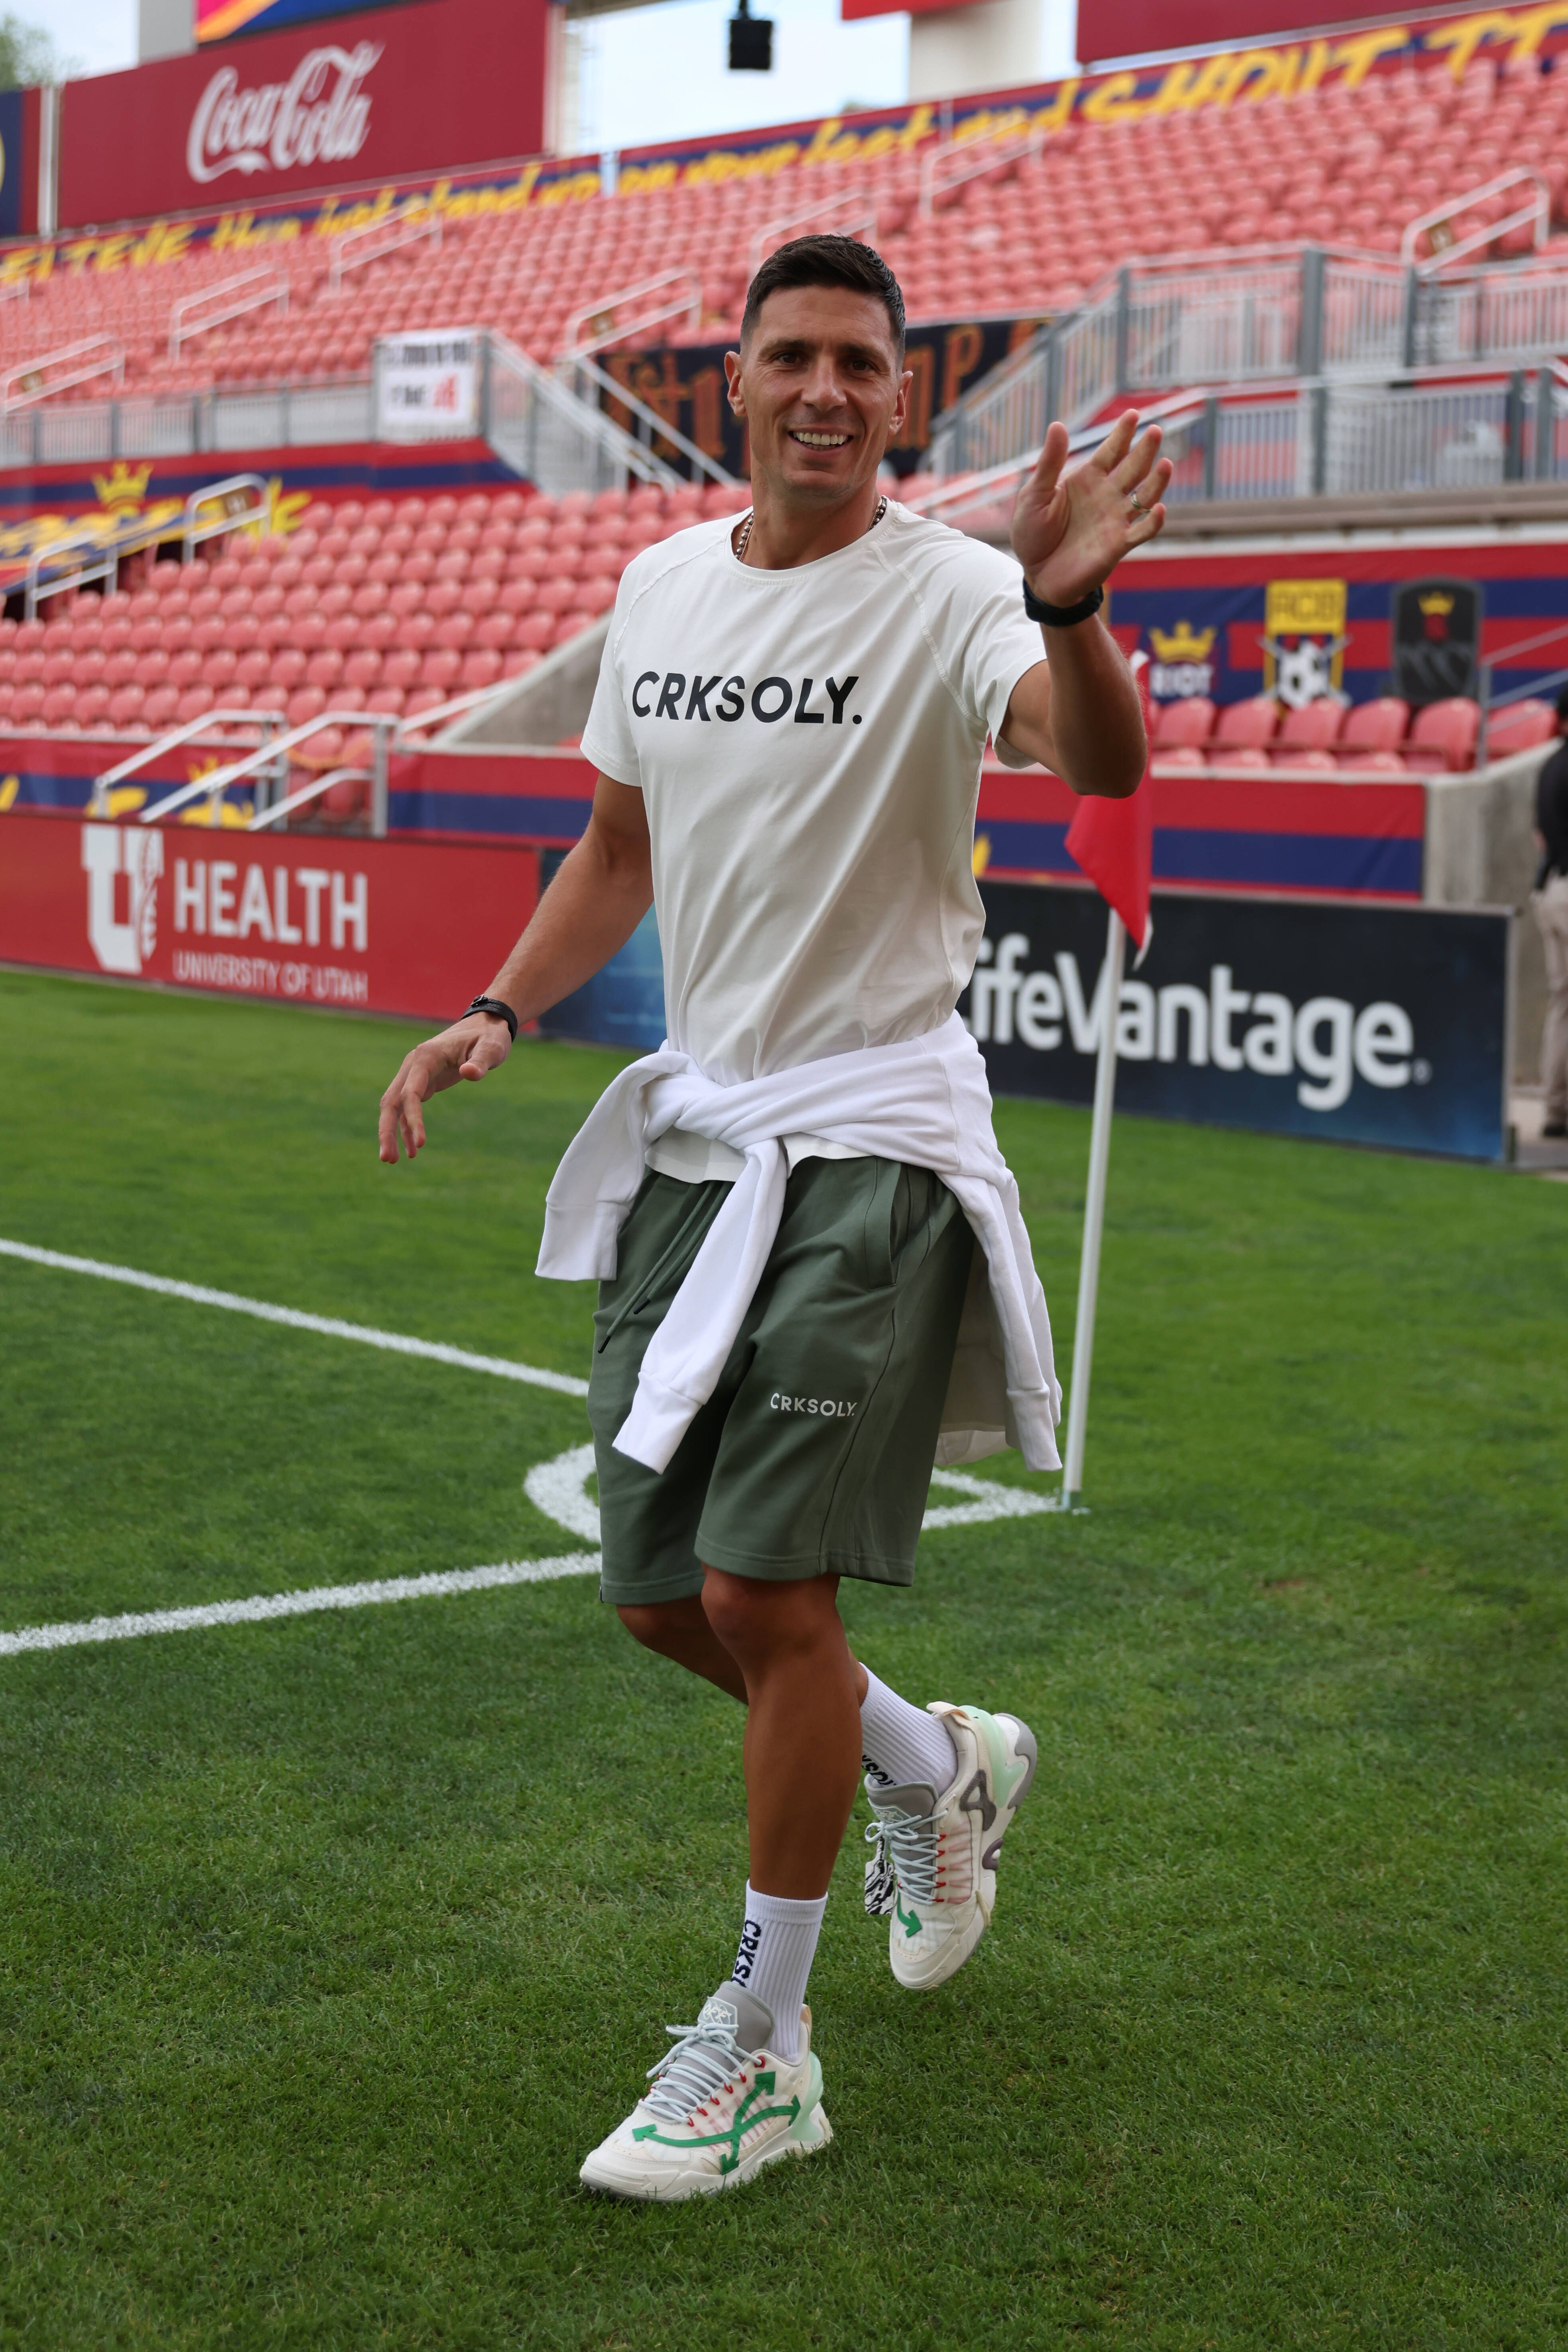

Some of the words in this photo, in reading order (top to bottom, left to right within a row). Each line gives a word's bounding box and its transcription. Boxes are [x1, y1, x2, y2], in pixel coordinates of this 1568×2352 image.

[632, 671, 862, 724] CRKSOLY.
[174, 857, 368, 951] HEALTH
[173, 950, 280, 993] UNIVERSITY
[280, 962, 312, 998] OF
[311, 963, 368, 1003] UTAH
[961, 932, 1414, 1112] ifeVantage
[770, 1393, 857, 1416] CRKSOLY.
